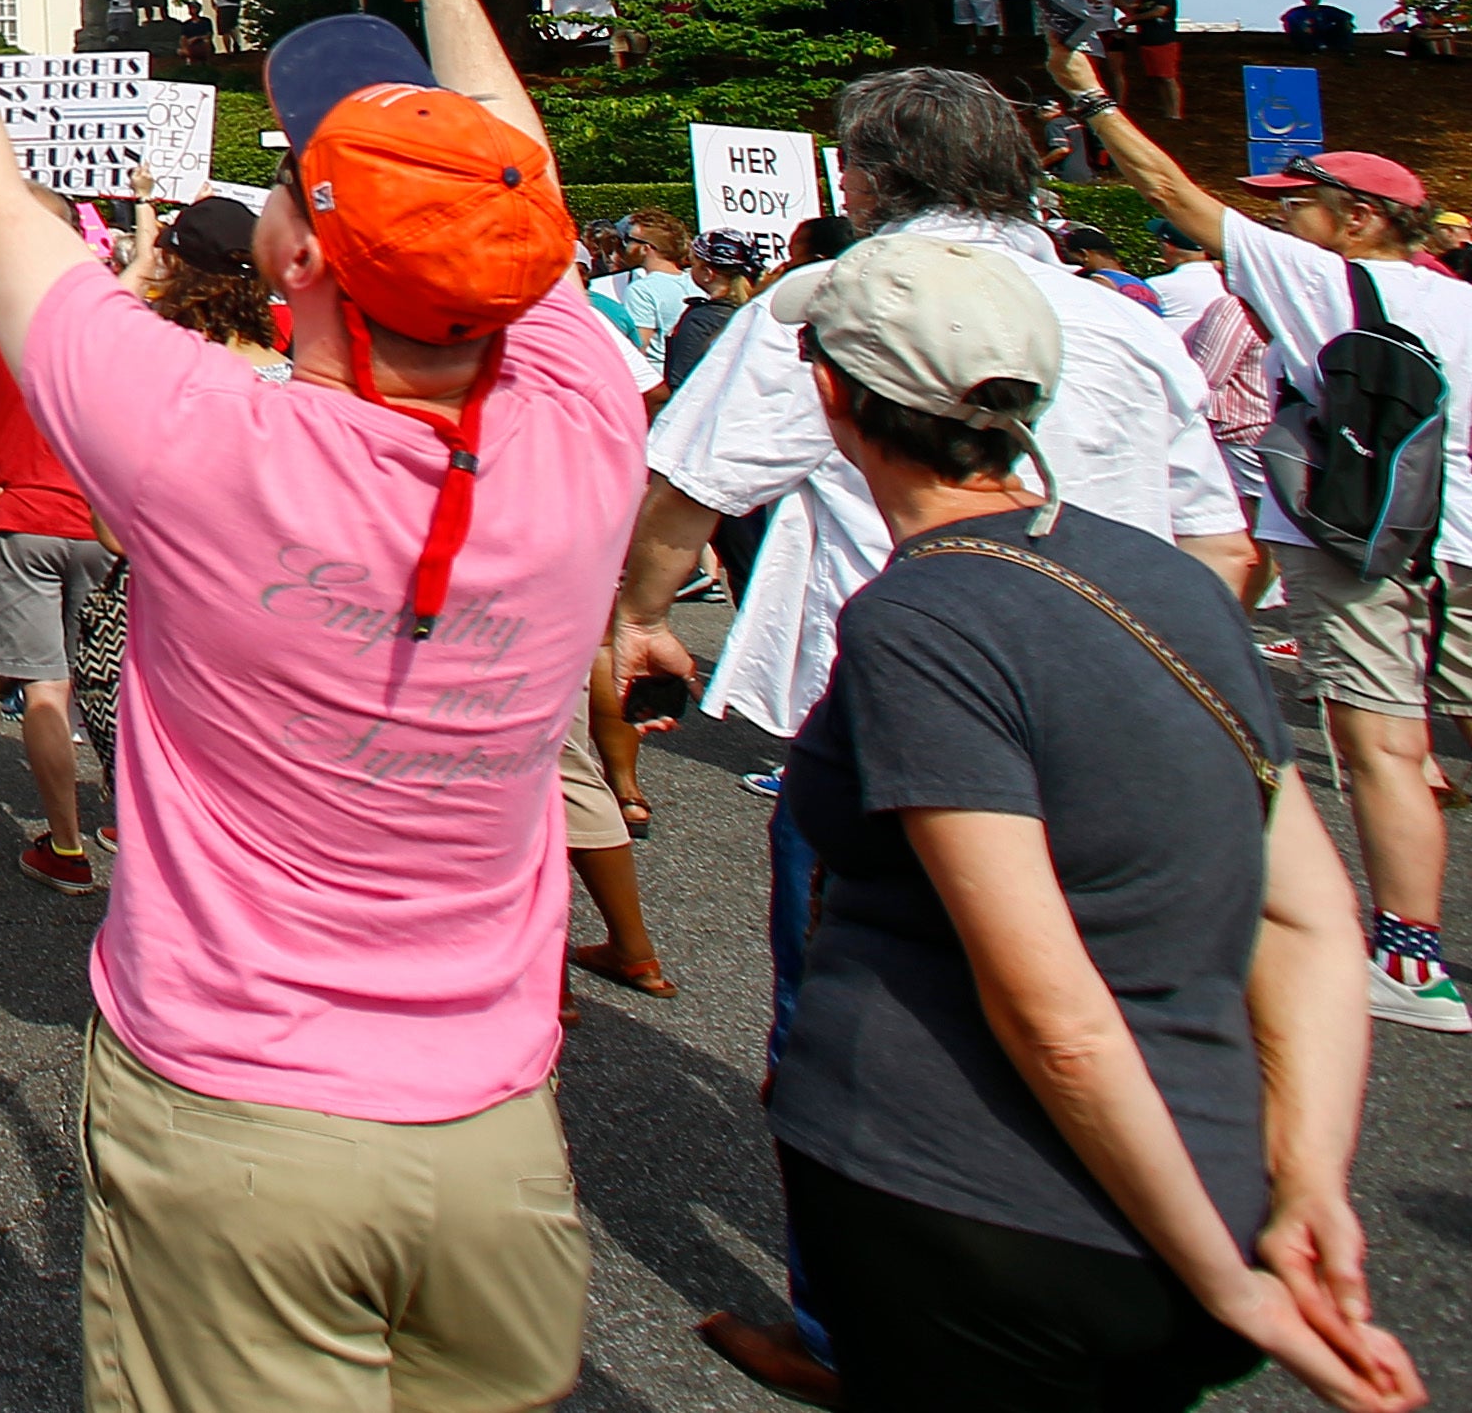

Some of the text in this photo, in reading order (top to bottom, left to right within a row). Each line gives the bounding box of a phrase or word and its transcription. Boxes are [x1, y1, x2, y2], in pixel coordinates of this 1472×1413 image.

[43, 57, 141, 77] RIGHTS
[42, 81, 139, 100] RIGHTS
[4, 106, 62, 123] EN'S
[147, 103, 196, 129] ORS
[50, 123, 146, 141] RIGHTS
[147, 127, 185, 148] THE
[25, 145, 143, 167] HUMAN
[149, 148, 210, 171] CE OF
[729, 146, 777, 176] HER
[721, 185, 790, 219] BODY
[429, 671, 528, 722] not
